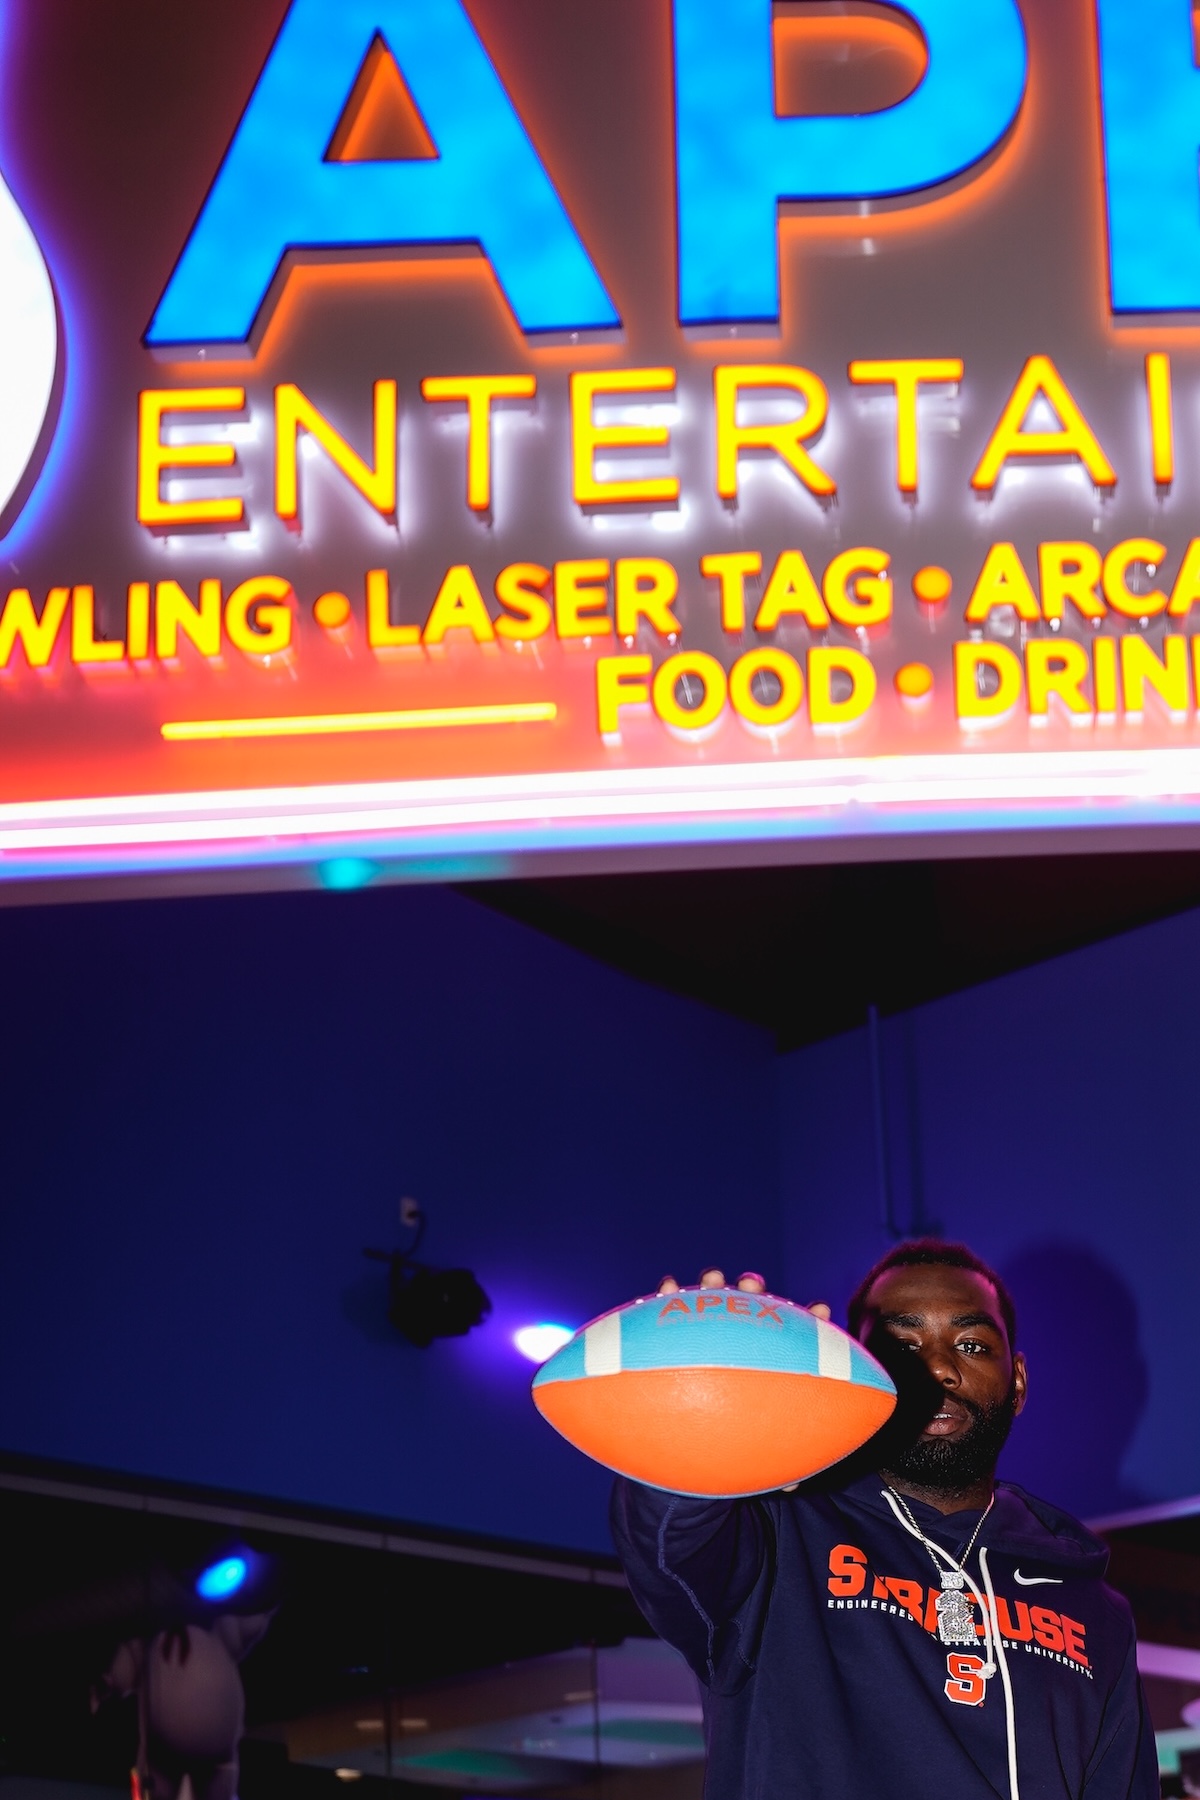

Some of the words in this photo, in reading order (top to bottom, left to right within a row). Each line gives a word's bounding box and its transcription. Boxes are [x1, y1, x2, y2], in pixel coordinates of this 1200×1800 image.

[366, 557, 680, 650] LASER
[702, 547, 893, 636] TAG
[595, 646, 878, 736] FOOD
[659, 1294, 785, 1326] APEX
[944, 1651, 986, 1707] S
